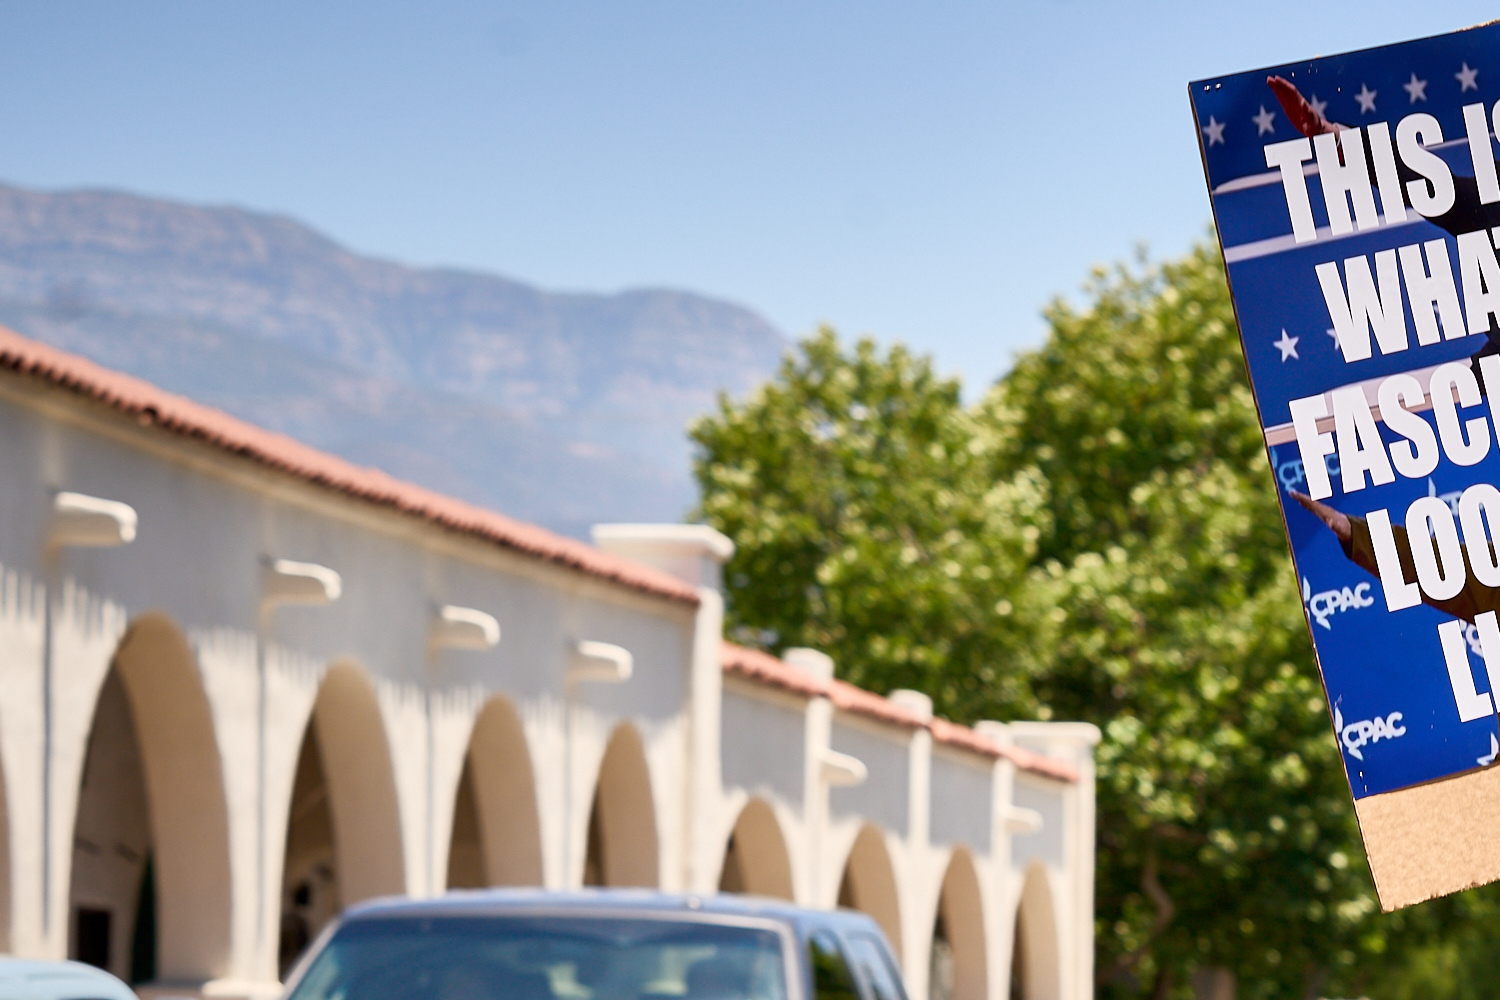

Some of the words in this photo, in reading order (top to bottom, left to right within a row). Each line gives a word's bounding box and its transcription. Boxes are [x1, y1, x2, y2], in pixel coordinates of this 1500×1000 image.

[1264, 114, 1455, 244] THIS
[1310, 582, 1374, 620] CPAC
[1342, 711, 1406, 751] CPAC
